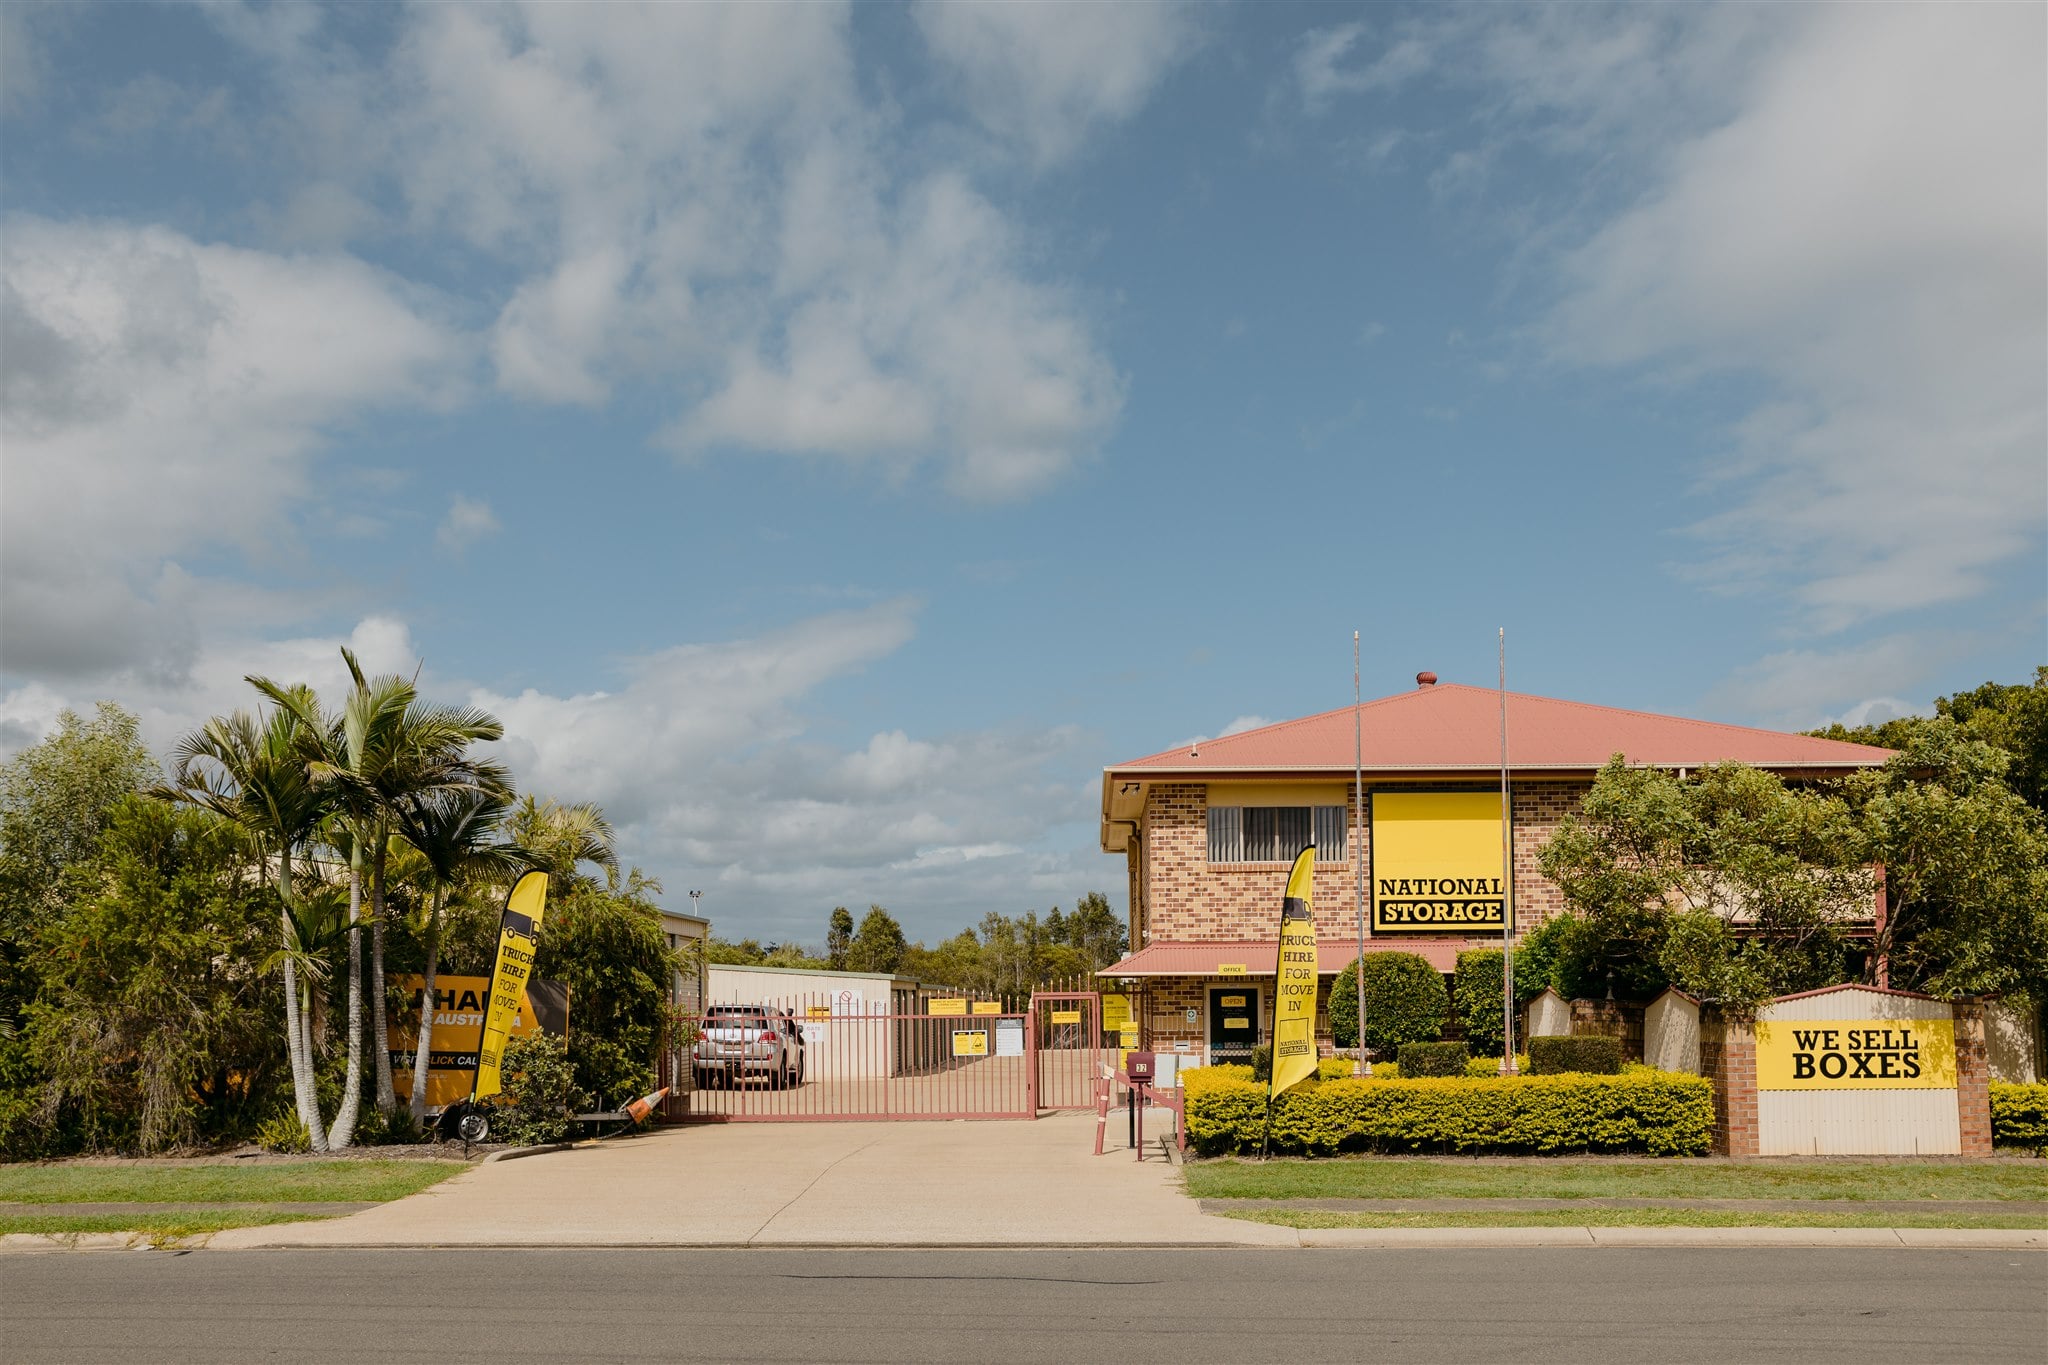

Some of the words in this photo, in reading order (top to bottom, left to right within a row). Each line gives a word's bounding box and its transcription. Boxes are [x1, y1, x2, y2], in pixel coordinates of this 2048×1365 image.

[1379, 878, 1505, 896] NATIONAL
[1385, 902, 1501, 921] STORAGE
[1282, 935, 1316, 946] TRUCK
[503, 945, 534, 965] TRUCK
[1283, 951, 1314, 962] HIRE
[501, 963, 526, 979] HIRE
[1285, 968, 1311, 979] FOR
[498, 979, 518, 993] FOR
[1281, 984, 1315, 995] MOVE
[1288, 1000, 1302, 1011] IN
[1792, 1029, 1840, 1050] WE
[1848, 1029, 1919, 1050] SELL
[429, 1055, 455, 1065] LICK
[1792, 1051, 1921, 1079] BOXES
